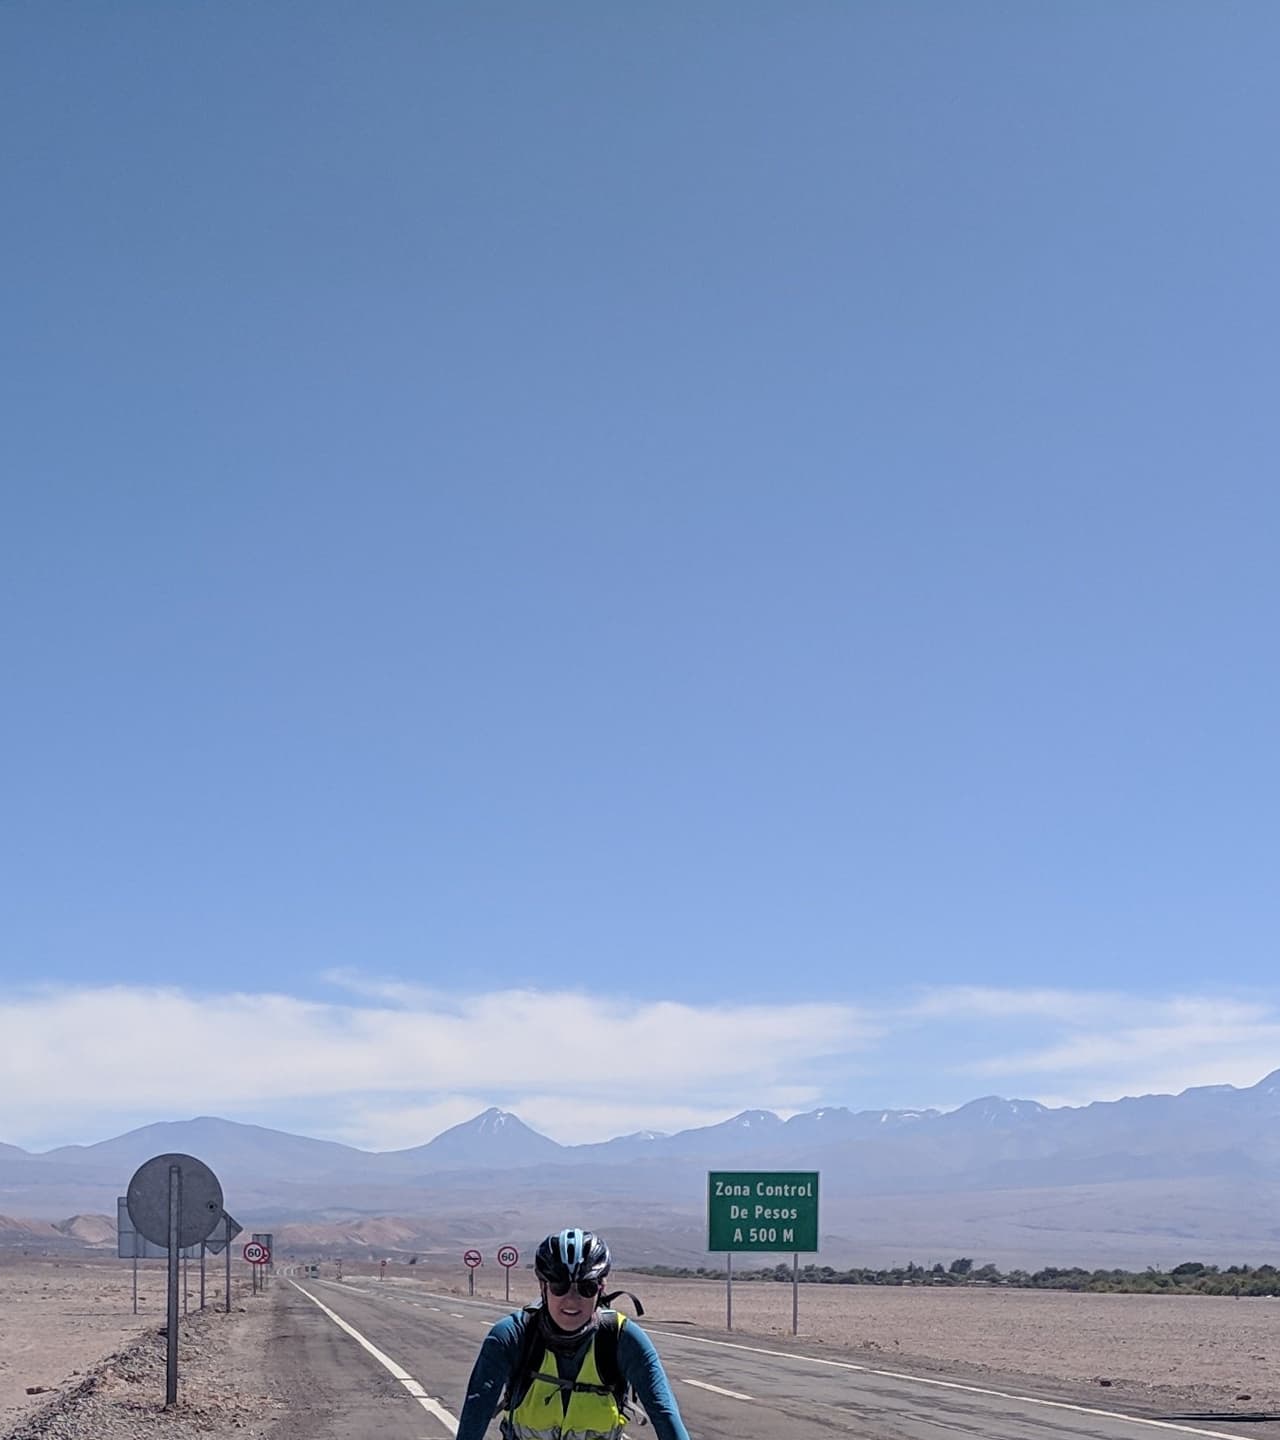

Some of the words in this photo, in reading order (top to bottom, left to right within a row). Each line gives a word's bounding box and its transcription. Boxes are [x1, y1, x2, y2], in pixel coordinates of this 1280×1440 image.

[715, 1182, 750, 1196] Zona
[756, 1182, 812, 1197] Control
[730, 1205, 748, 1219] De
[755, 1205, 798, 1219] Pesos
[733, 1228, 743, 1242] A
[749, 1228, 776, 1242] 500
[783, 1228, 794, 1242] M
[247, 1248, 261, 1257] 60
[501, 1252, 515, 1261] 60
